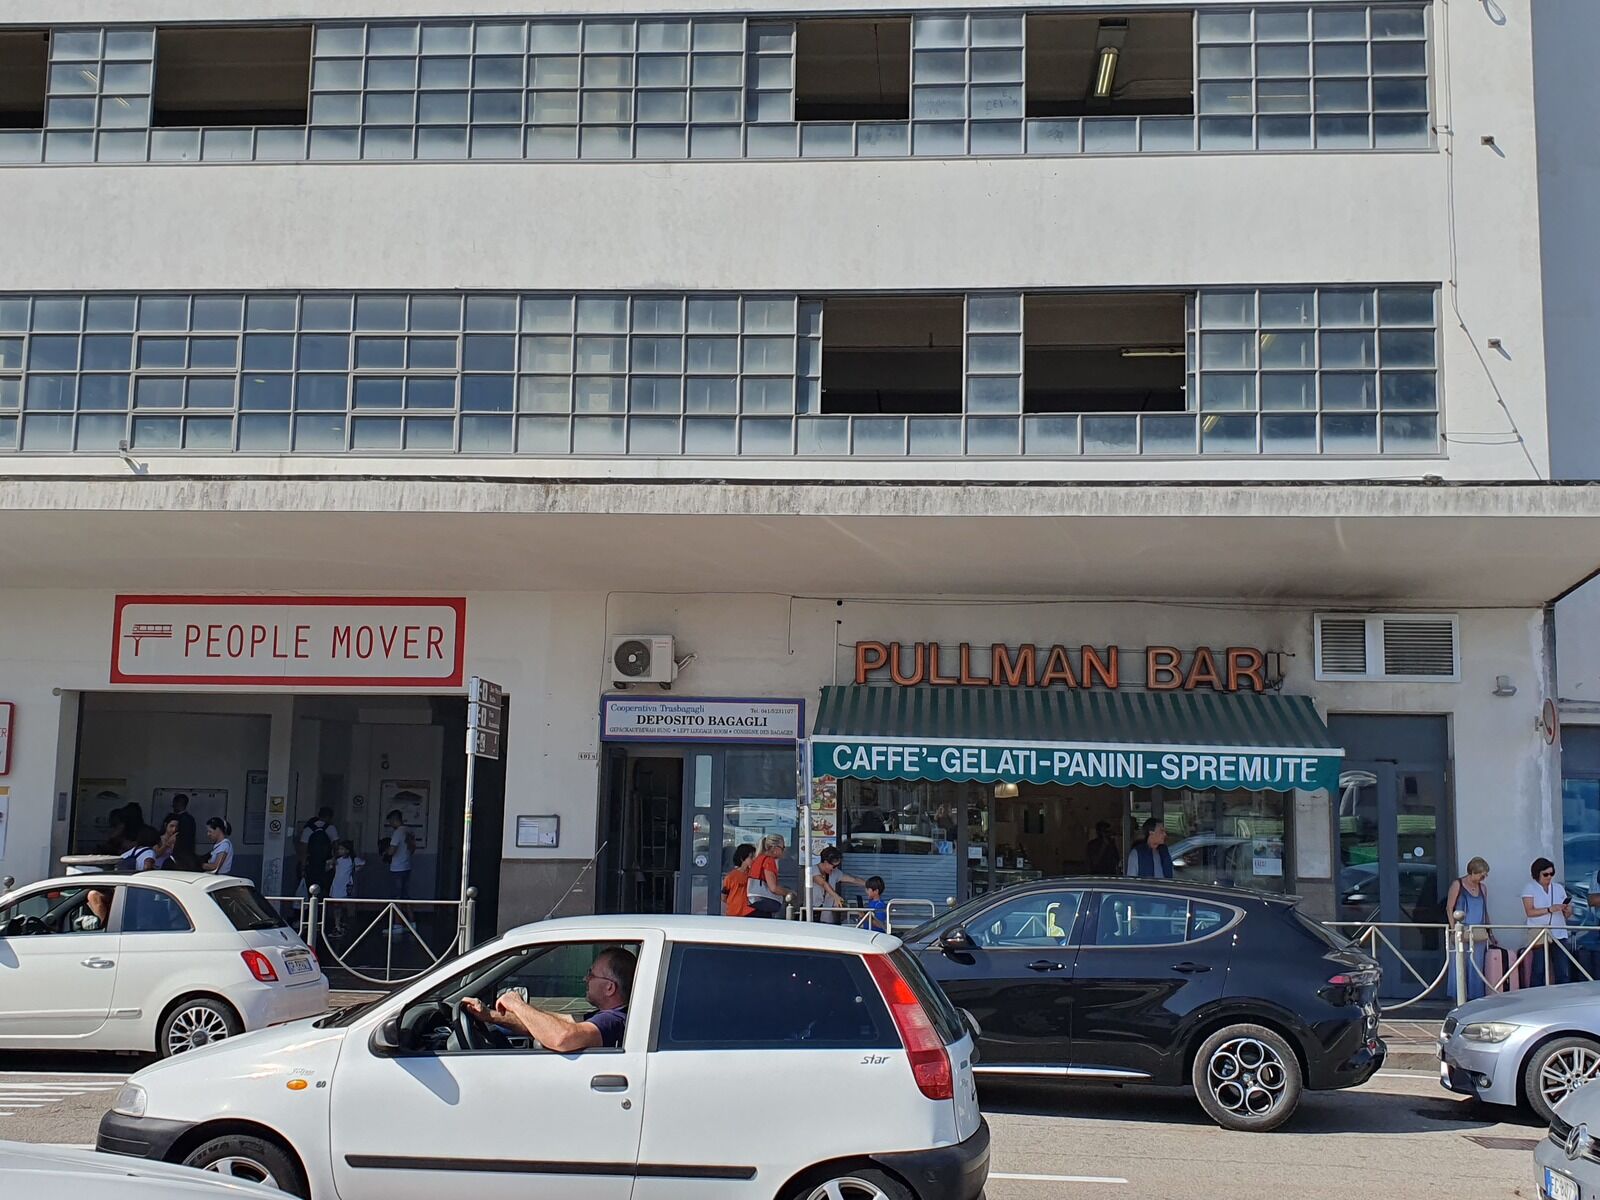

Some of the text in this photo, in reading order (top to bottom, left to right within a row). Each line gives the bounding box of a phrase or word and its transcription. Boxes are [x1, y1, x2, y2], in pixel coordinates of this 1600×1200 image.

[184, 624, 445, 660] PEOPLE MOVER
[855, 641, 1265, 693] PULLMAN BAR
[610, 703, 657, 713] Cooperativa
[636, 714, 768, 727] DEPOSITO BAGAGLI
[860, 1054, 892, 1065] star
[315, 1080, 327, 1089] 60
